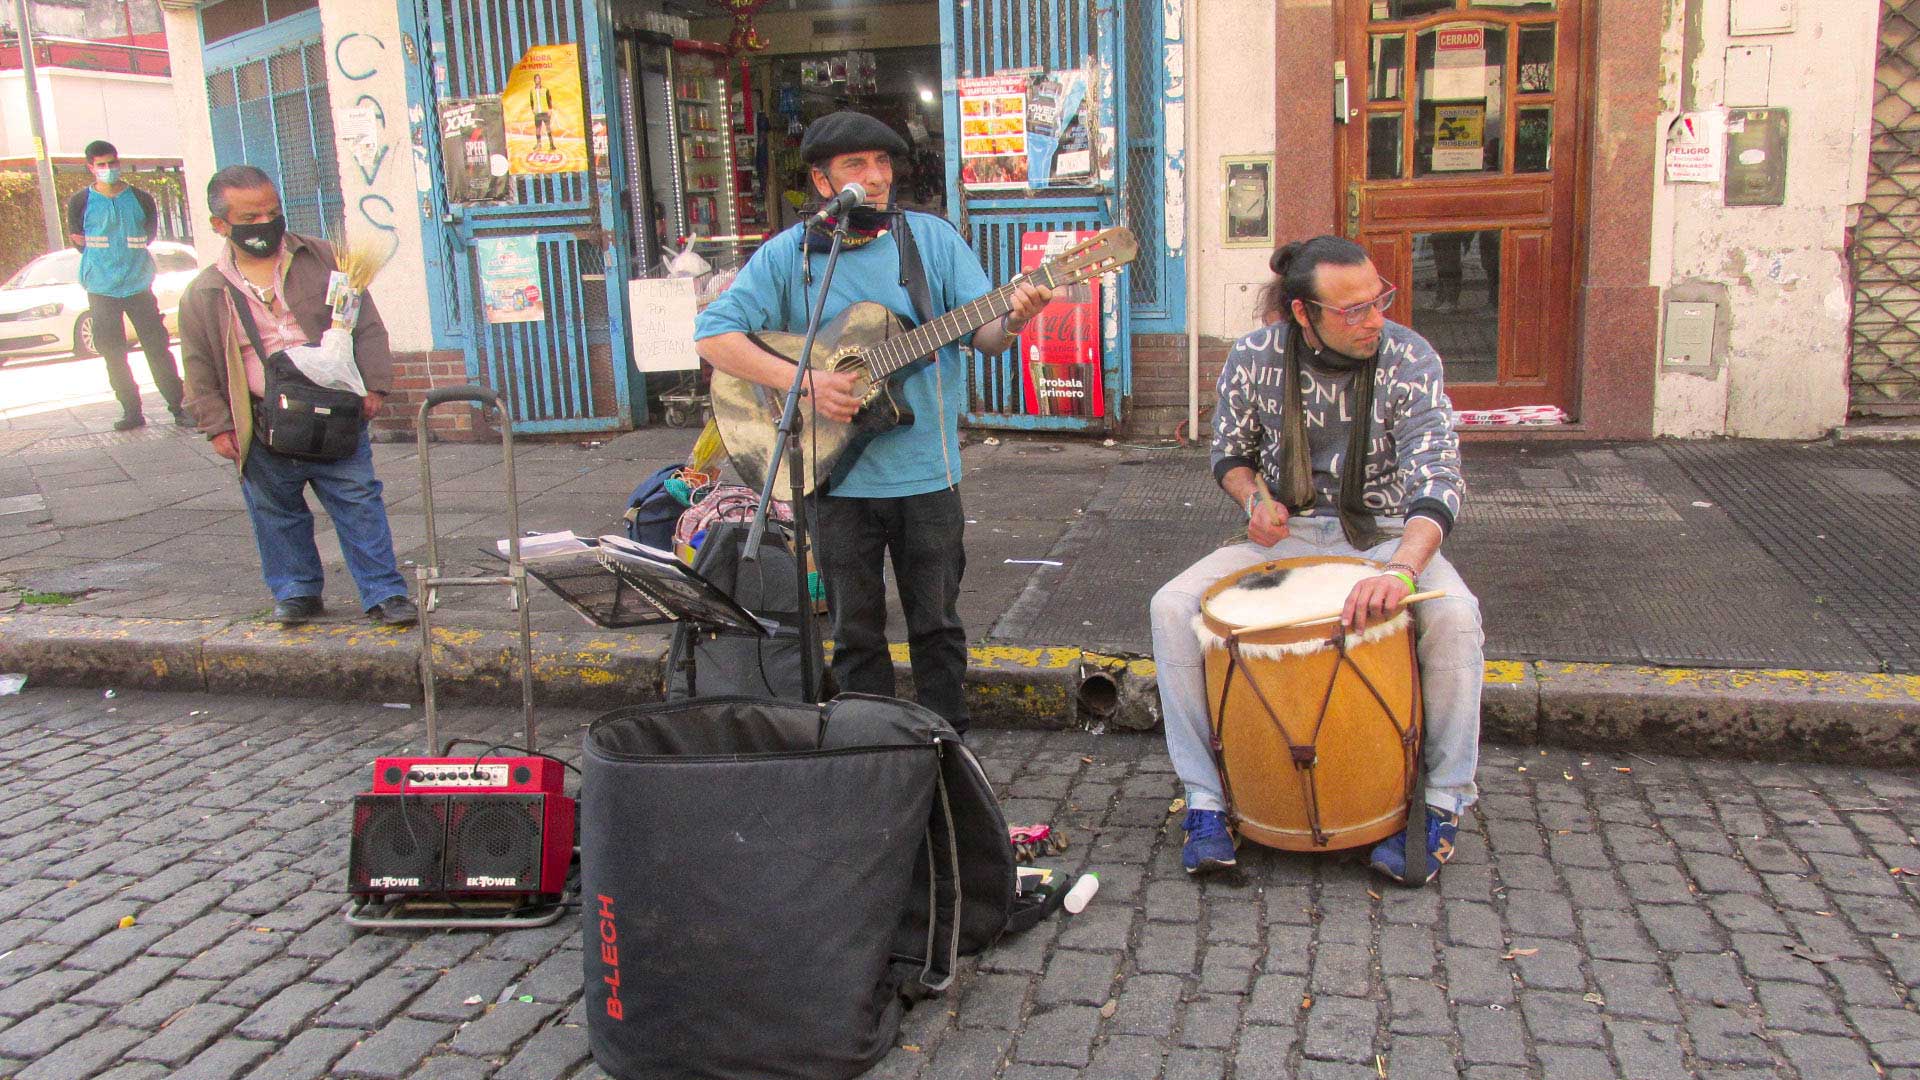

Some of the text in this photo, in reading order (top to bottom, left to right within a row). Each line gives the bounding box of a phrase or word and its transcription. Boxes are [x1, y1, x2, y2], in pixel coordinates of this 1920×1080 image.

[1440, 33, 1479, 46] CERRADO
[1027, 104, 1056, 116] POWER
[445, 112, 477, 132] XXL
[1034, 113, 1055, 123] ADE
[465, 141, 486, 155] SPEED
[1669, 147, 1710, 155] PELIGRO
[1024, 243, 1039, 251] ¿La
[637, 320, 666, 336] SAN
[1039, 377, 1083, 387] Probala
[1040, 388, 1084, 399] primero
[370, 876, 419, 888] EK-TOWER
[467, 876, 516, 888] EK-TOWER
[597, 894, 623, 1021] B-LECH
